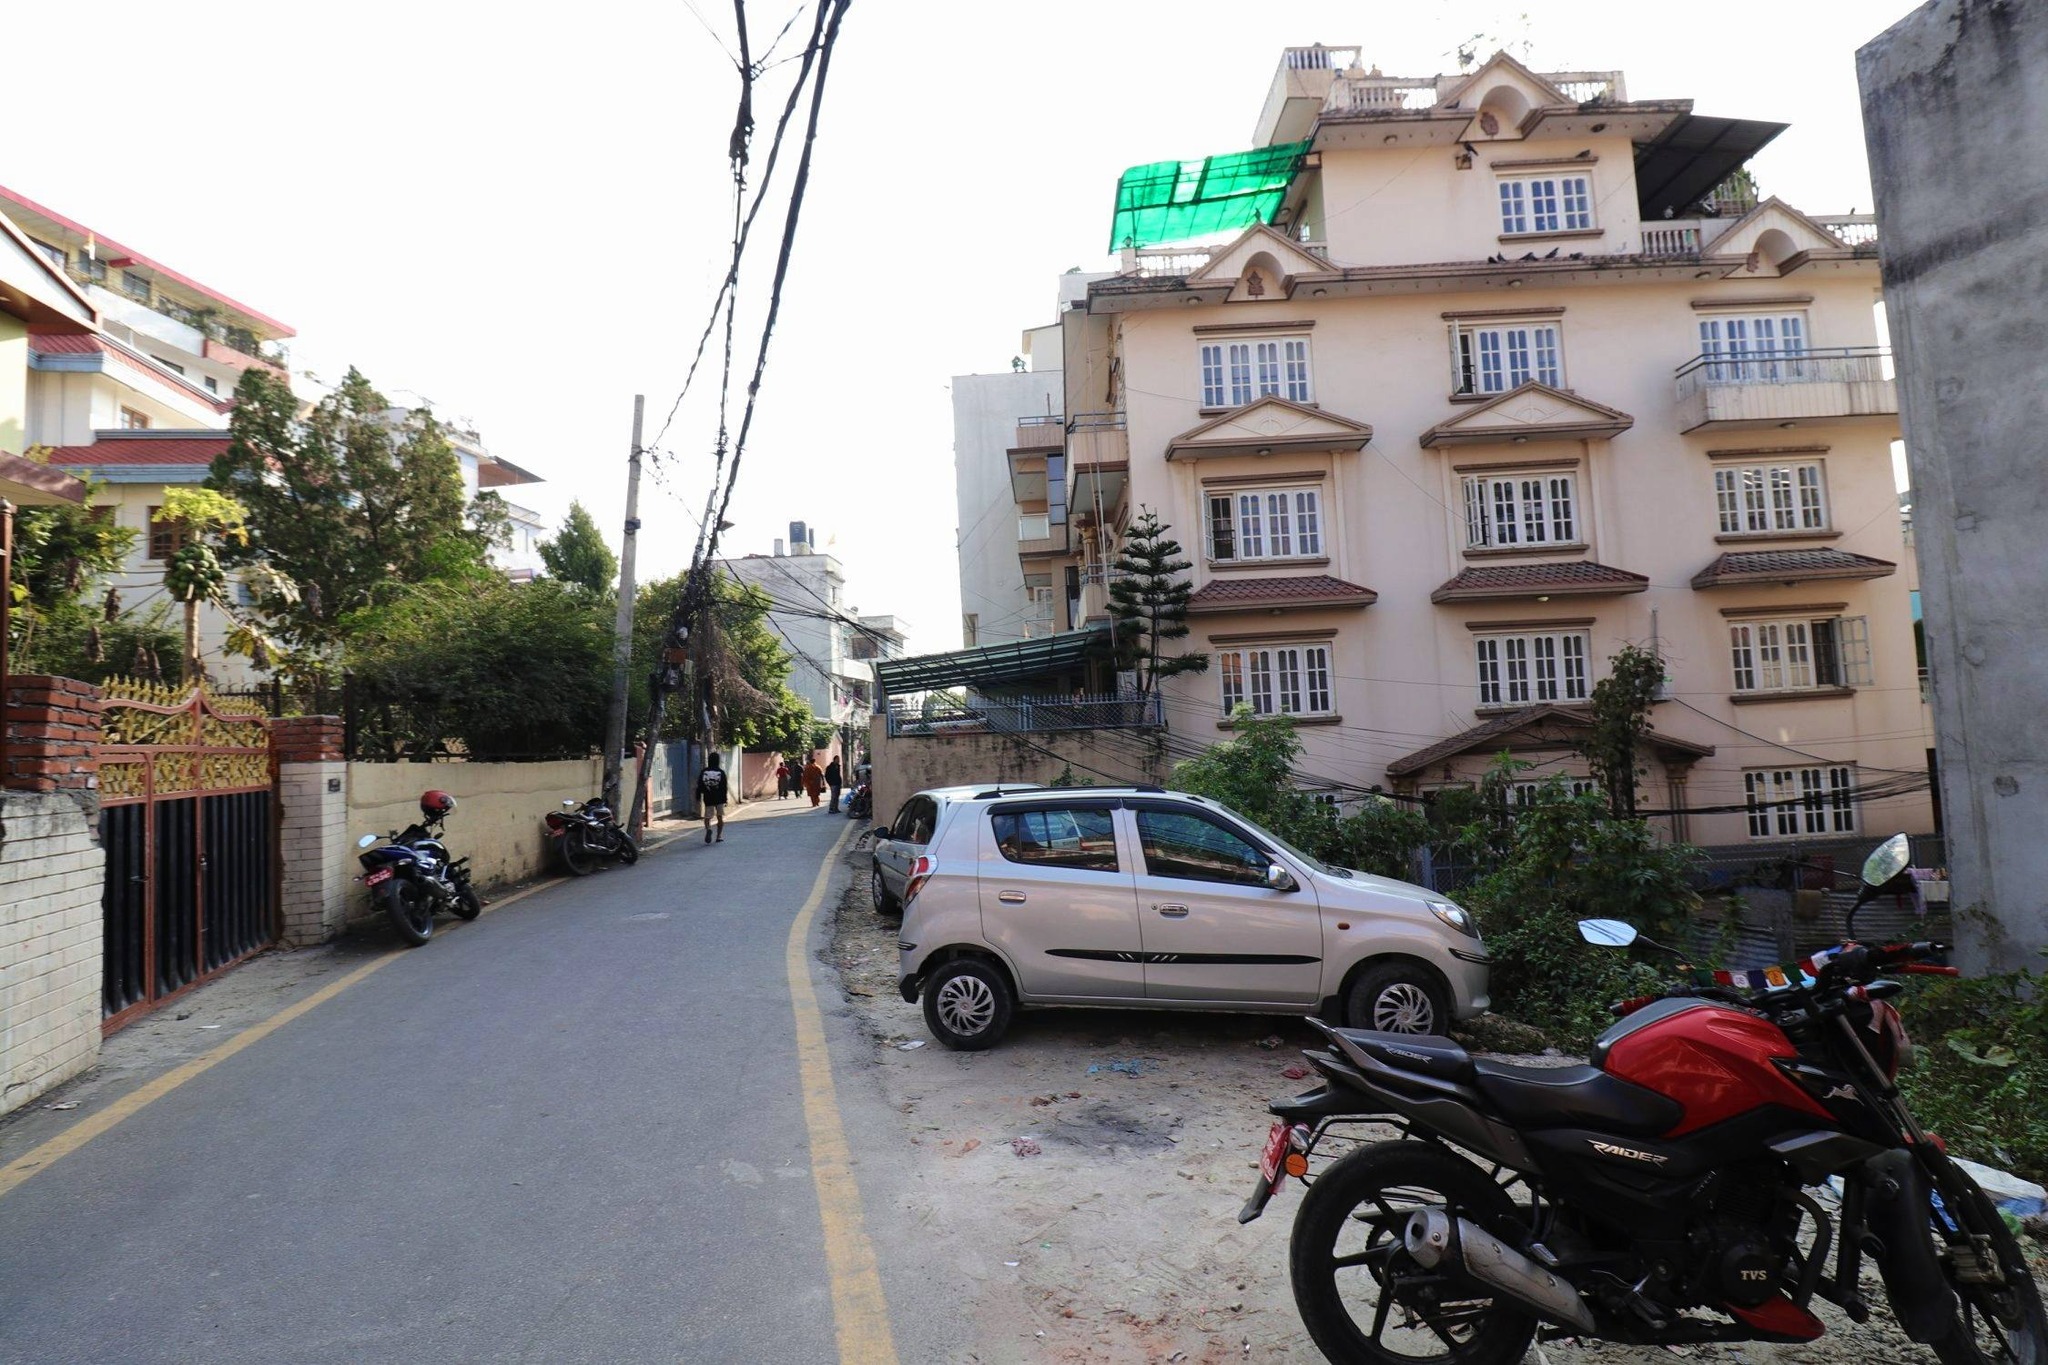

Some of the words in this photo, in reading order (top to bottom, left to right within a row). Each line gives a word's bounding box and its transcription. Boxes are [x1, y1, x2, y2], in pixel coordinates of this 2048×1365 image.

[1381, 1043, 1433, 1064] RAIDER
[1586, 1139, 1669, 1168] RAIDER
[1740, 1270, 1767, 1280] TVS
